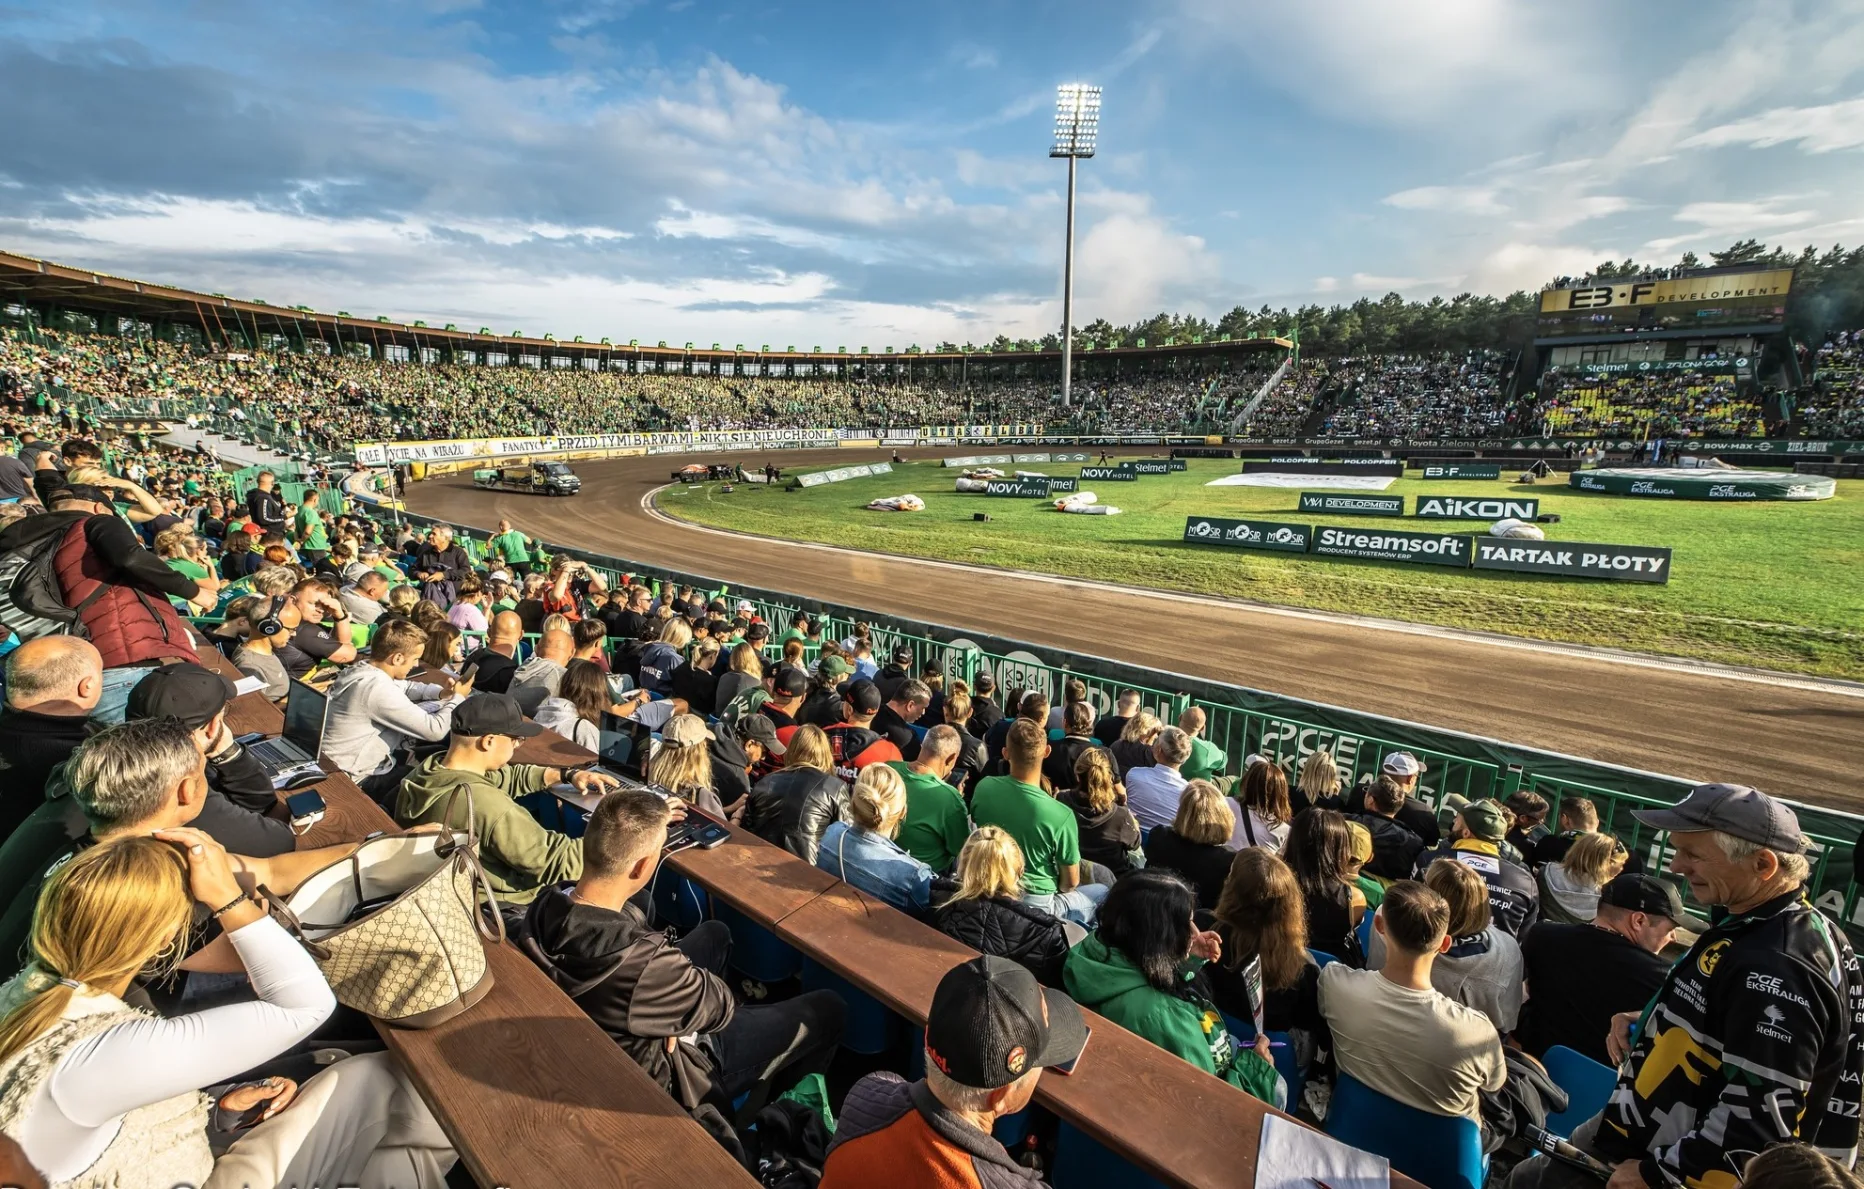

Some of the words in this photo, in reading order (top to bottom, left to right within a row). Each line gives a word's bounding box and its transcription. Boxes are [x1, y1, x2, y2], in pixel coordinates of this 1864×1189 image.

[1658, 286, 1780, 302] DEVELOPMENT
[1586, 363, 1628, 373] Stelmet
[922, 426, 971, 436] ULTRAS
[984, 425, 1041, 435] FALUBAZ
[558, 436, 598, 449] PRZED
[600, 434, 632, 447] TYMI
[763, 441, 784, 449] NOVY
[1229, 437, 1265, 445] GrupaGezet
[1408, 439, 1438, 448] Toyota
[1440, 439, 1475, 447] Zielona
[1477, 438, 1503, 448] Góra
[386, 447, 411, 460] YCIE
[415, 446, 428, 458] NA
[1081, 468, 1113, 479] NOVY
[1134, 463, 1167, 473] Stelmet
[987, 483, 1023, 494] NOVY
[1631, 487, 1674, 495] EKSTRALIGA
[1325, 499, 1399, 510] DEVELOPMENT
[1318, 547, 1357, 555] PRODUCENT
[1358, 550, 1396, 559] SYSTEMÓW
[1481, 545, 1573, 566] TARTAK
[1581, 553, 1665, 573] PŁOTY
[1467, 859, 1488, 869] PGE
[1485, 883, 1512, 896] SIEWICZ
[1746, 971, 1784, 988] PGE
[1746, 980, 1811, 1009] EKSTRALIGA
[1755, 1023, 1793, 1044] Stelmet
